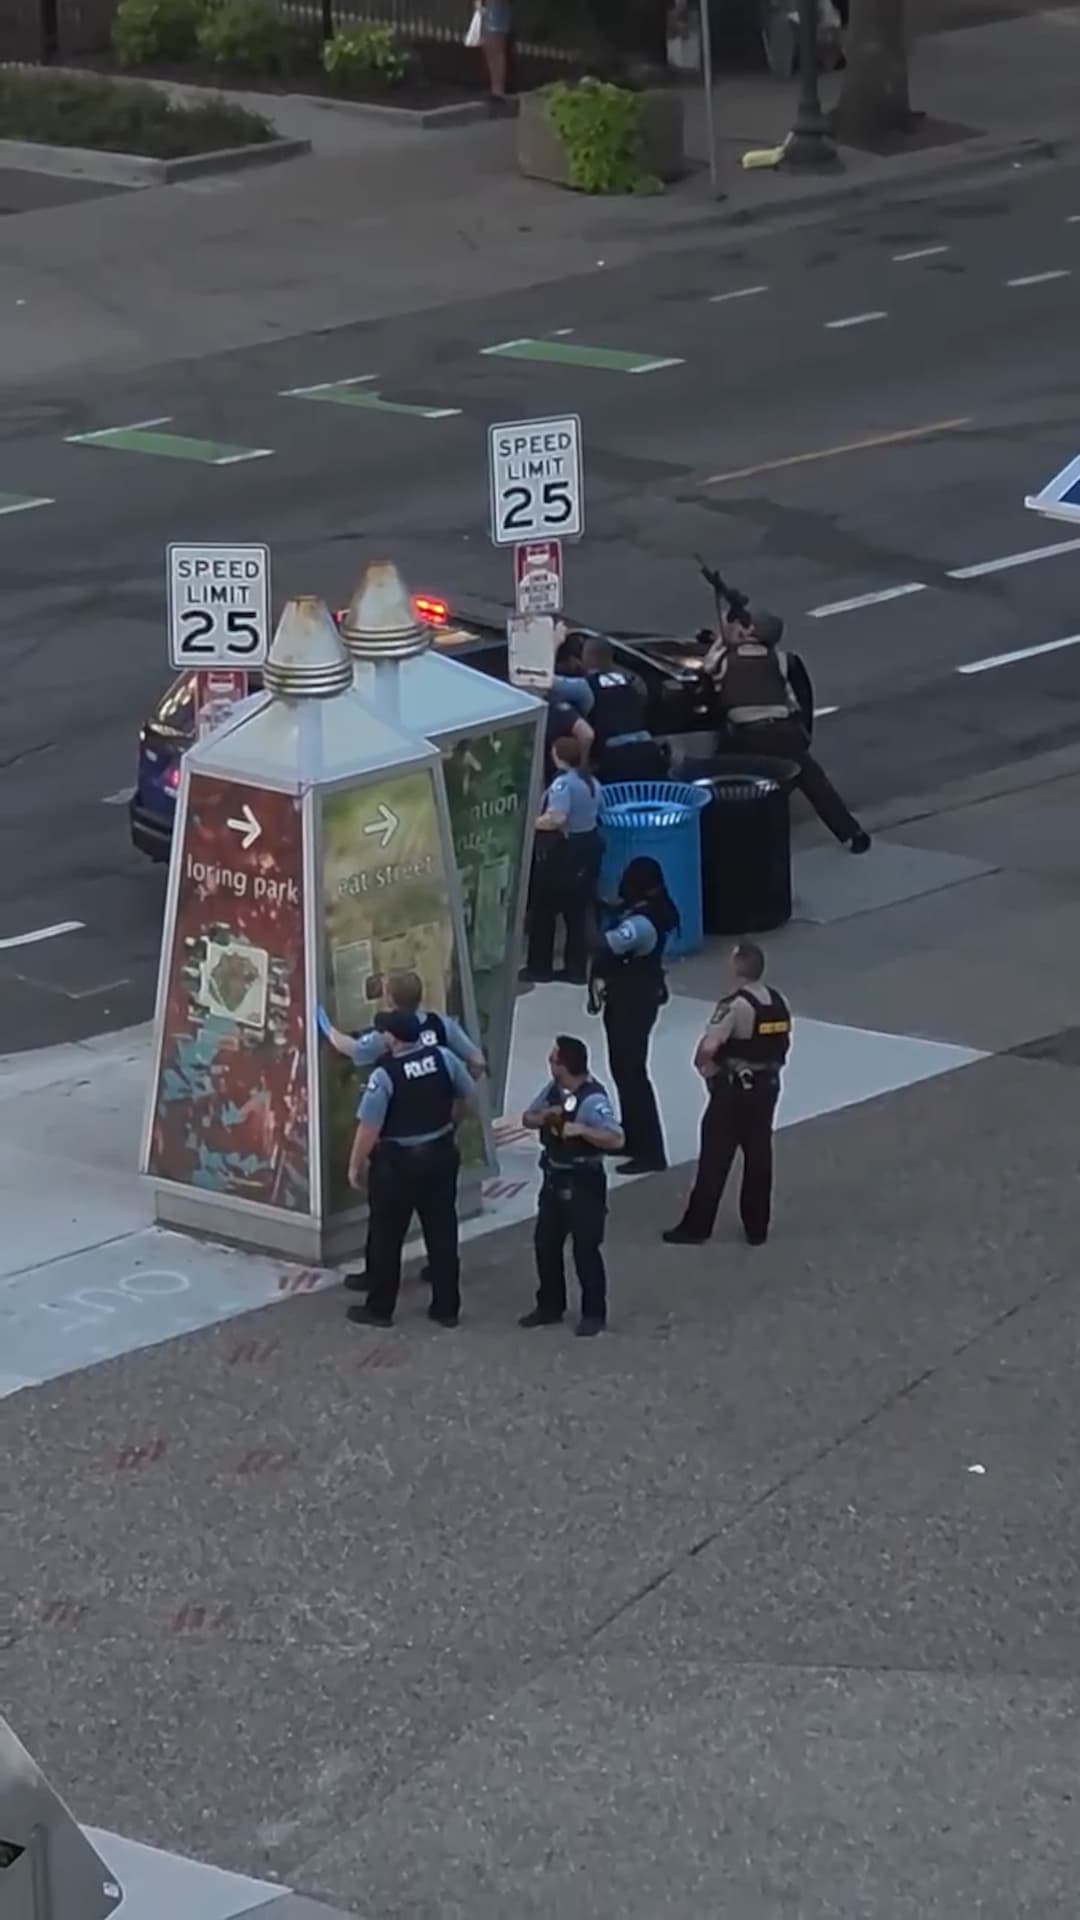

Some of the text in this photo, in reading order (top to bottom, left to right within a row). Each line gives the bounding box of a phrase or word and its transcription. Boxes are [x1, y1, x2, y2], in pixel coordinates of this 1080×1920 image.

[499, 432, 571, 457] SPEED
[507, 457, 564, 480] LIMIT
[502, 481, 572, 529] 25
[178, 560, 260, 578] SPEED
[187, 585, 250, 603] LIMIT
[180, 610, 259, 654] 25
[186, 853, 299, 905] loring park
[337, 856, 433, 898] eat street
[403, 1055, 438, 1080] POLICE
